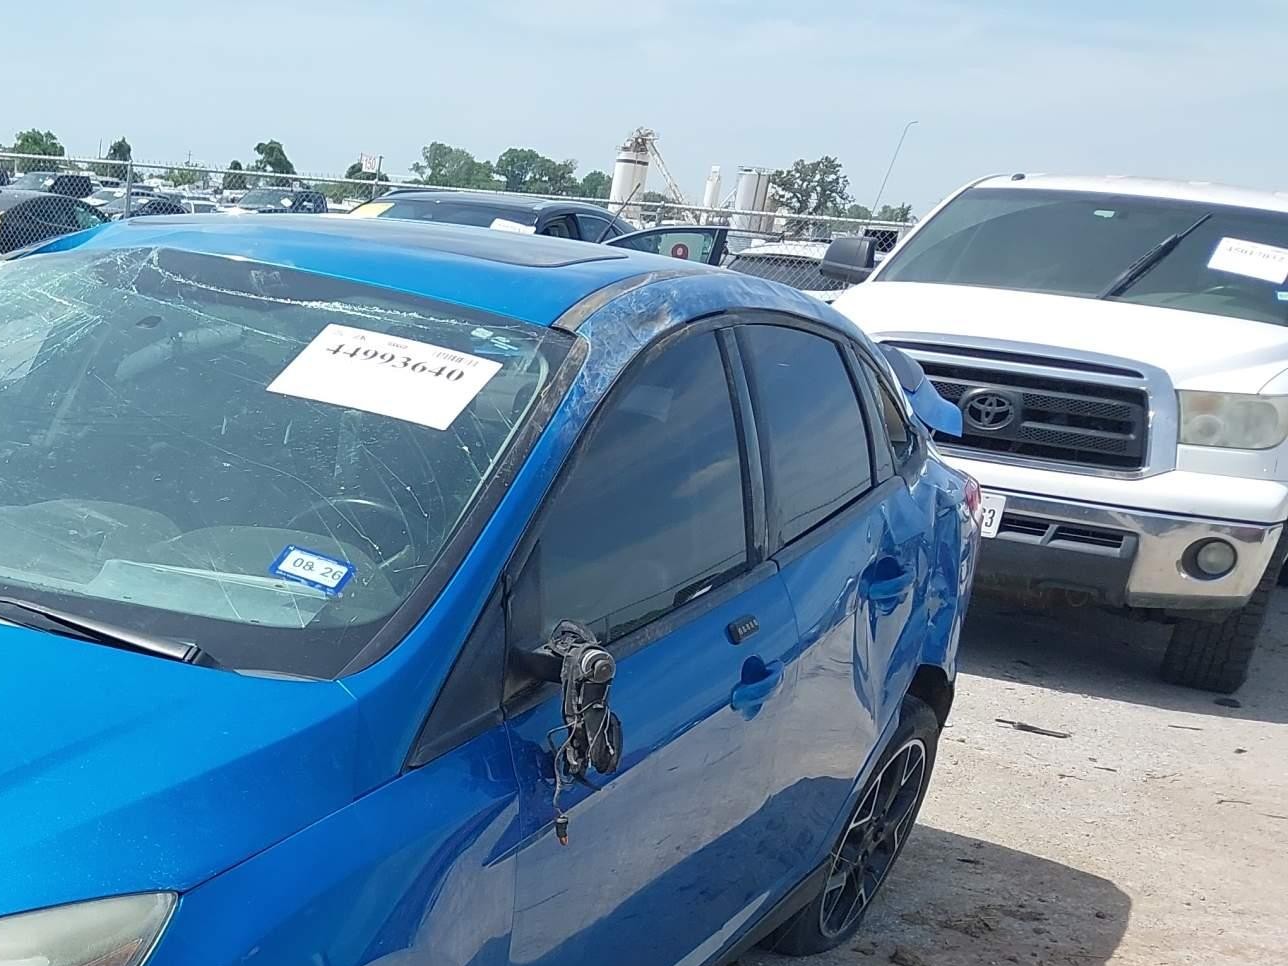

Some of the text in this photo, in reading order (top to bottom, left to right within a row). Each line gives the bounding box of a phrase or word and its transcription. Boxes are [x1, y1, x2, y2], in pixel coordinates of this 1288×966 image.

[325, 343, 465, 382] 44993640
[292, 557, 344, 581] 08 26
